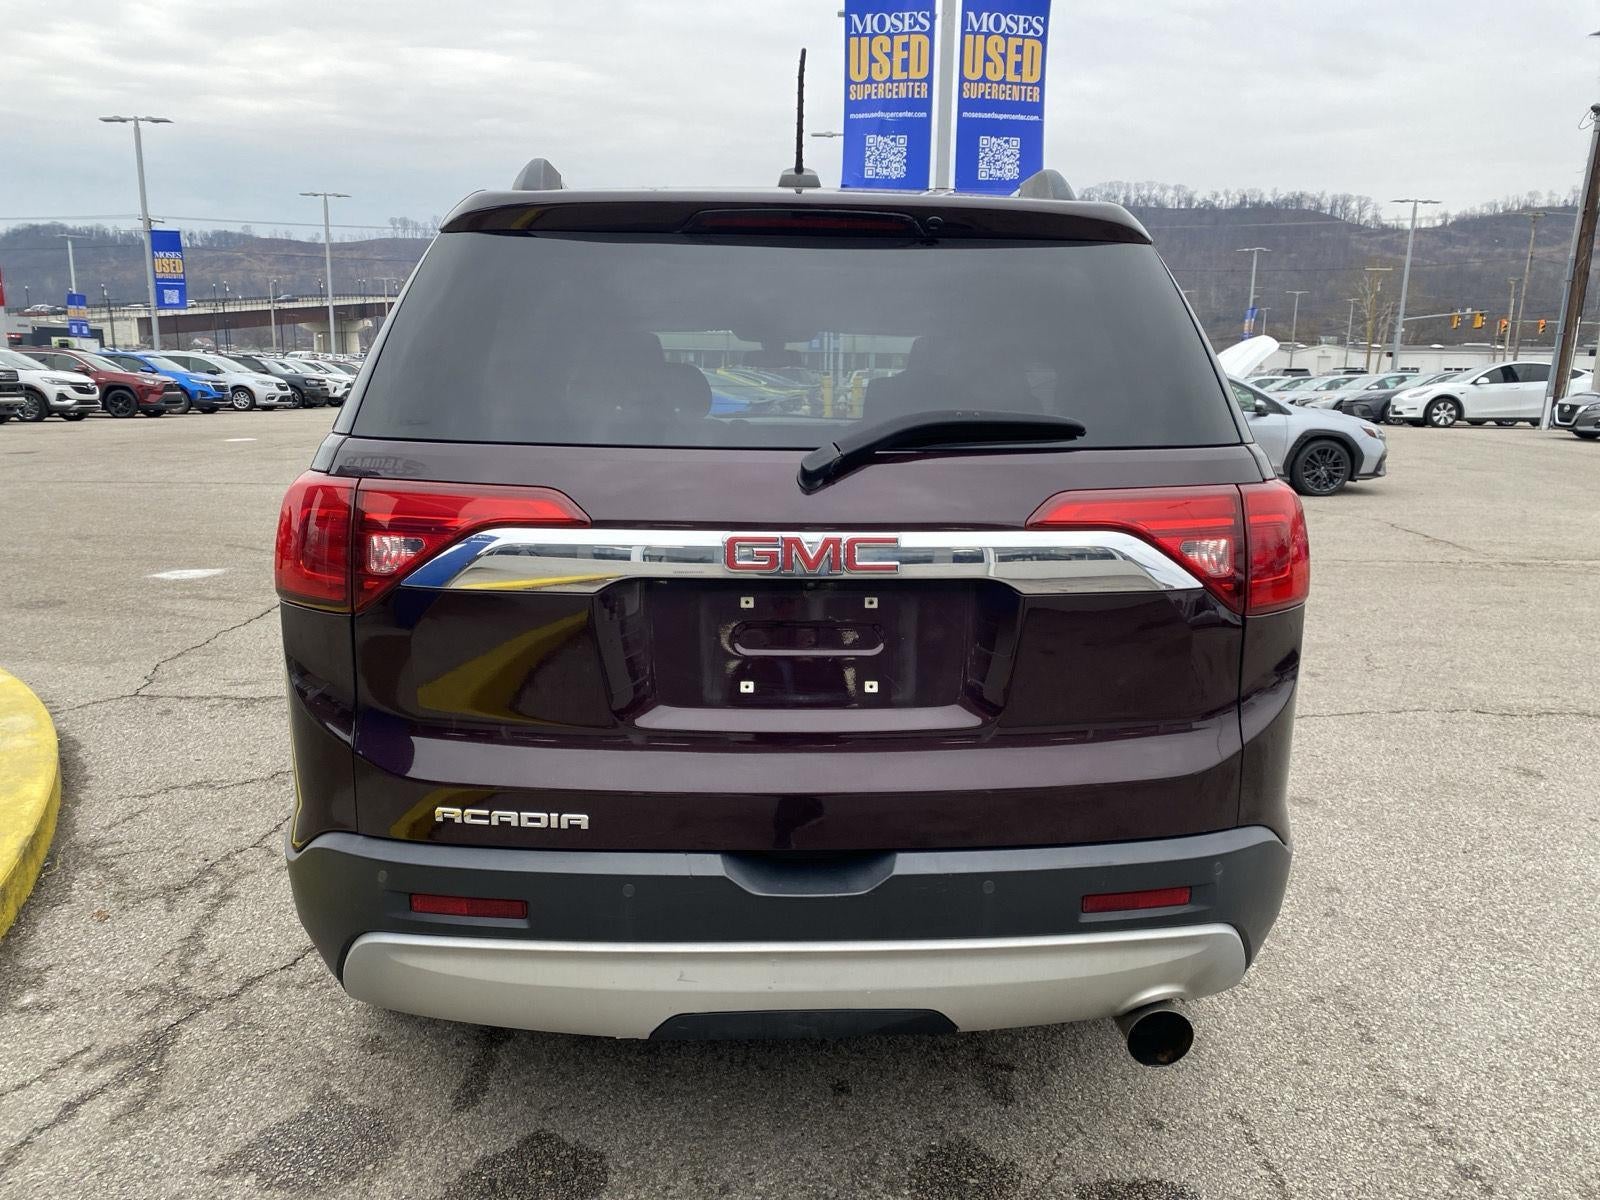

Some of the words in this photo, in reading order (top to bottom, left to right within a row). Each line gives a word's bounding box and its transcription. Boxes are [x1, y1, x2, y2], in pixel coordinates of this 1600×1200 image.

[851, 11, 930, 34] MOSES
[966, 11, 1044, 37] MOSES
[850, 34, 929, 82] USED
[963, 34, 1043, 83] USED
[850, 82, 928, 100] SUPERCENTER
[963, 82, 1040, 102] SUPERCENTER
[850, 110, 927, 119] mosesusedsupercenter.com
[962, 111, 1040, 121] mosesusedsupercenter.com
[154, 258, 184, 273] USED
[723, 536, 900, 573] GMC
[435, 807, 589, 829] ACADIA
